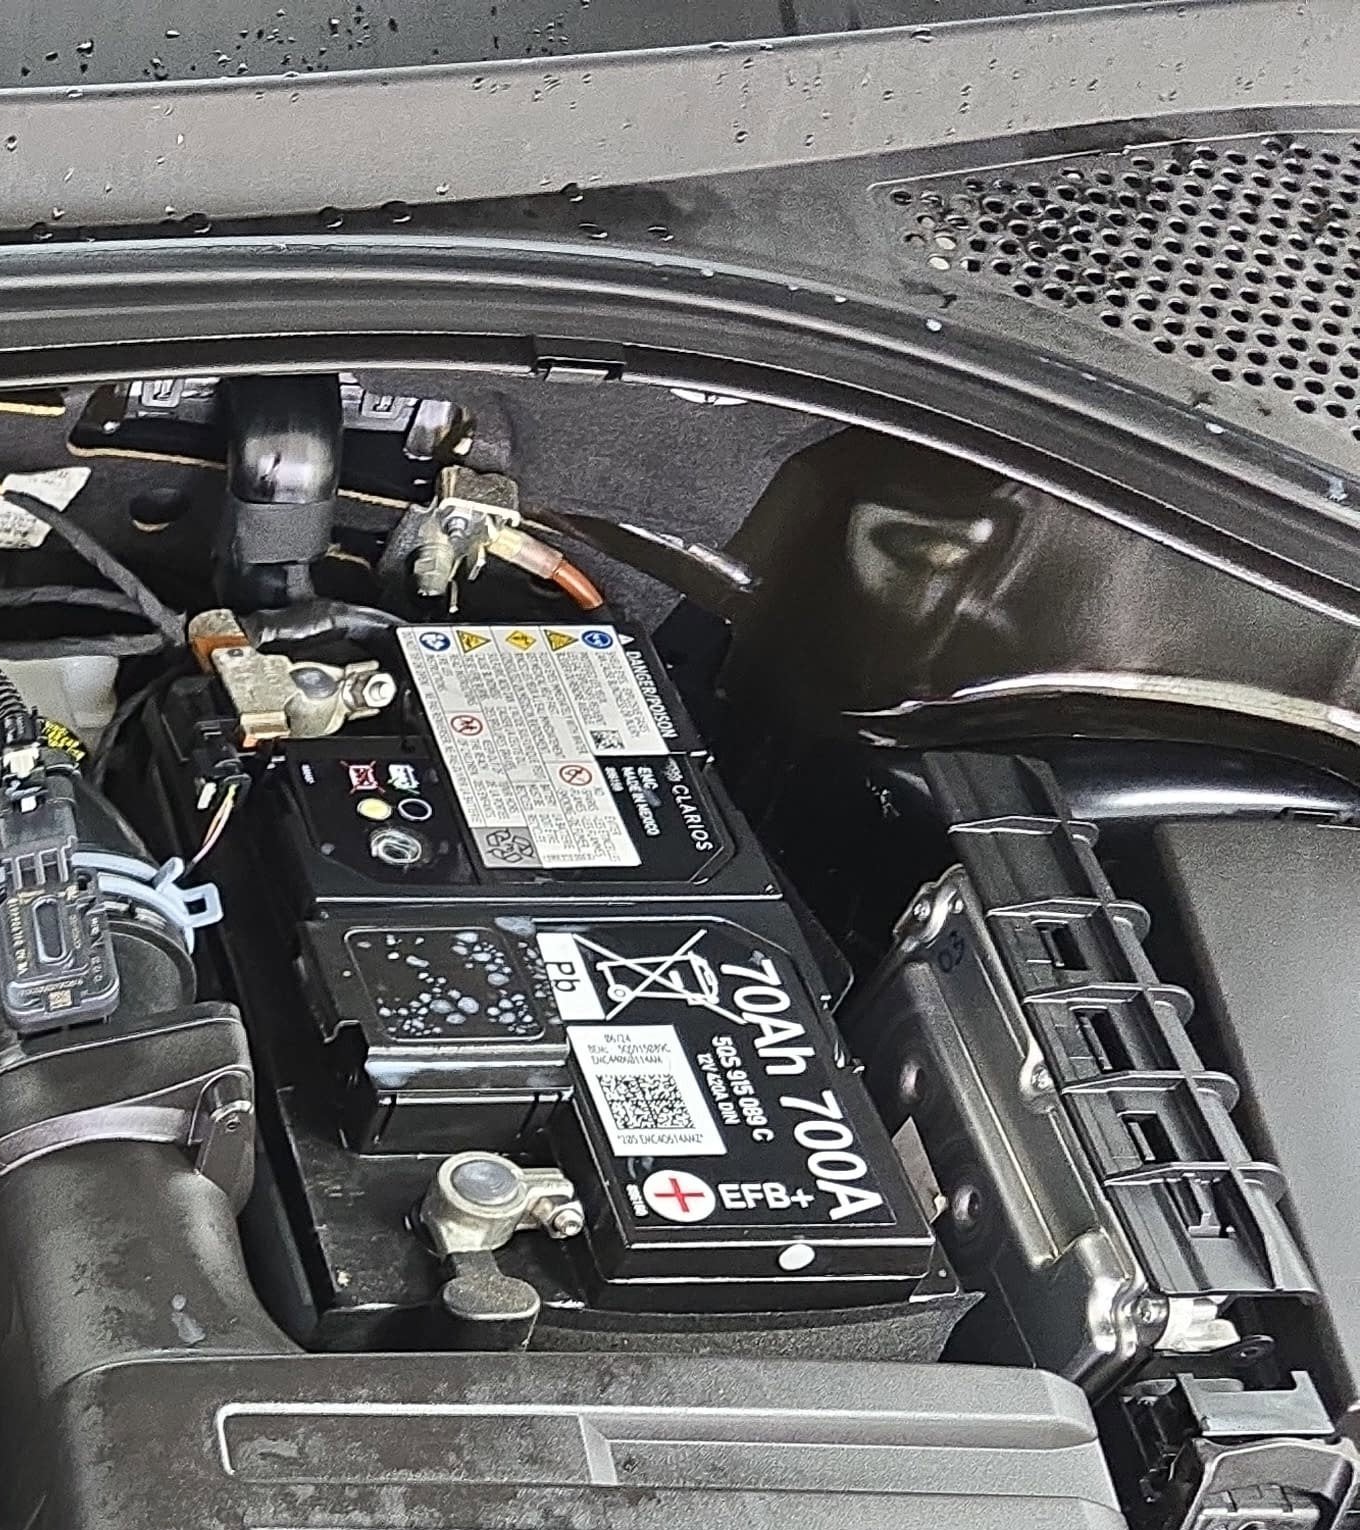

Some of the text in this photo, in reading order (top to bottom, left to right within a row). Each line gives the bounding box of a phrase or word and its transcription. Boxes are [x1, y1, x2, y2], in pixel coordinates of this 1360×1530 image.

[626, 651, 678, 739] DANGER/POISON
[636, 802, 660, 837] MEXICO
[672, 784, 713, 850] CLARIOS
[544, 961, 580, 992] Pb
[720, 959, 884, 1220] 70Ah 700A
[726, 1067, 755, 1097] 915
[718, 1101, 741, 1125] DIN
[739, 1096, 768, 1126] 089
[752, 1127, 774, 1142] C
[717, 1181, 815, 1209] EFB+
